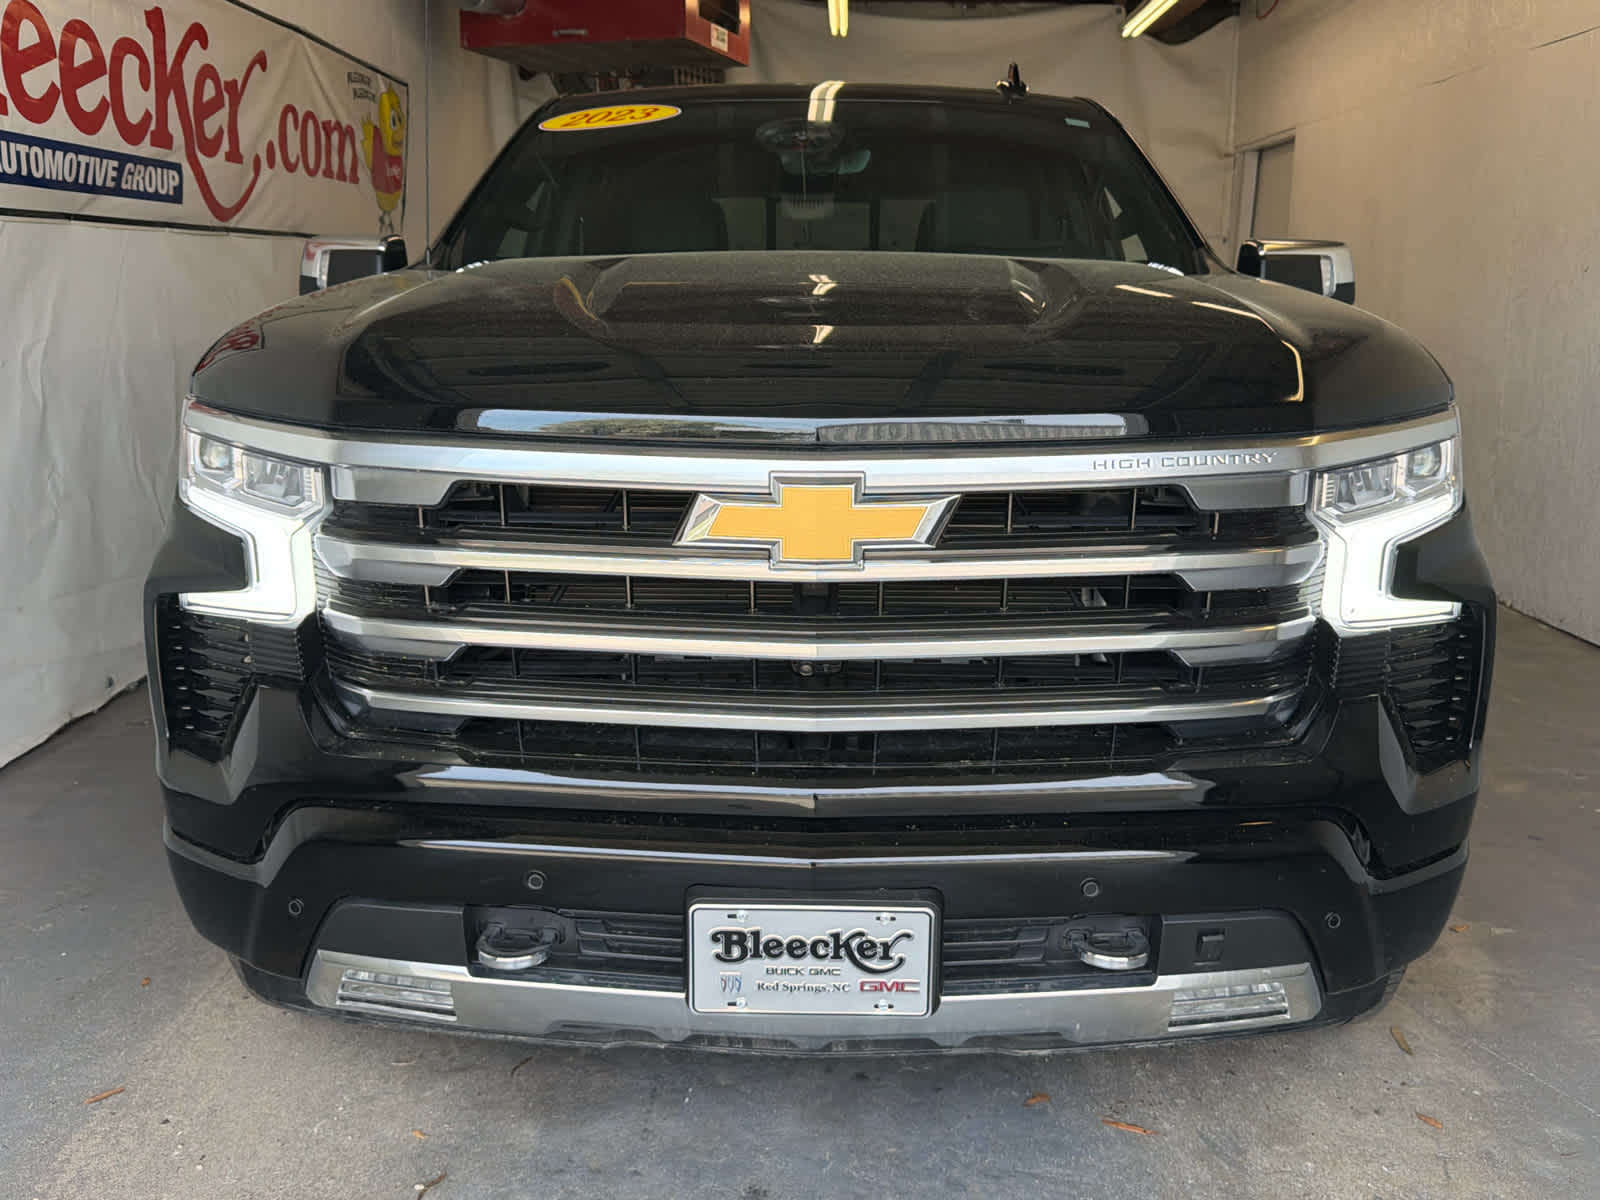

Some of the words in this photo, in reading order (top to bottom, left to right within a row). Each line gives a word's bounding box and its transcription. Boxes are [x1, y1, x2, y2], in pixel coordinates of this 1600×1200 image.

[561, 107, 659, 127] 2023
[121, 162, 180, 196] GROUP
[1093, 458, 1151, 470] HIGH
[1161, 452, 1277, 468] COUNTRY
[766, 967, 804, 976] BUICK
[809, 968, 841, 976] GMC
[757, 981, 780, 992] Red
[859, 980, 920, 993] GMC
